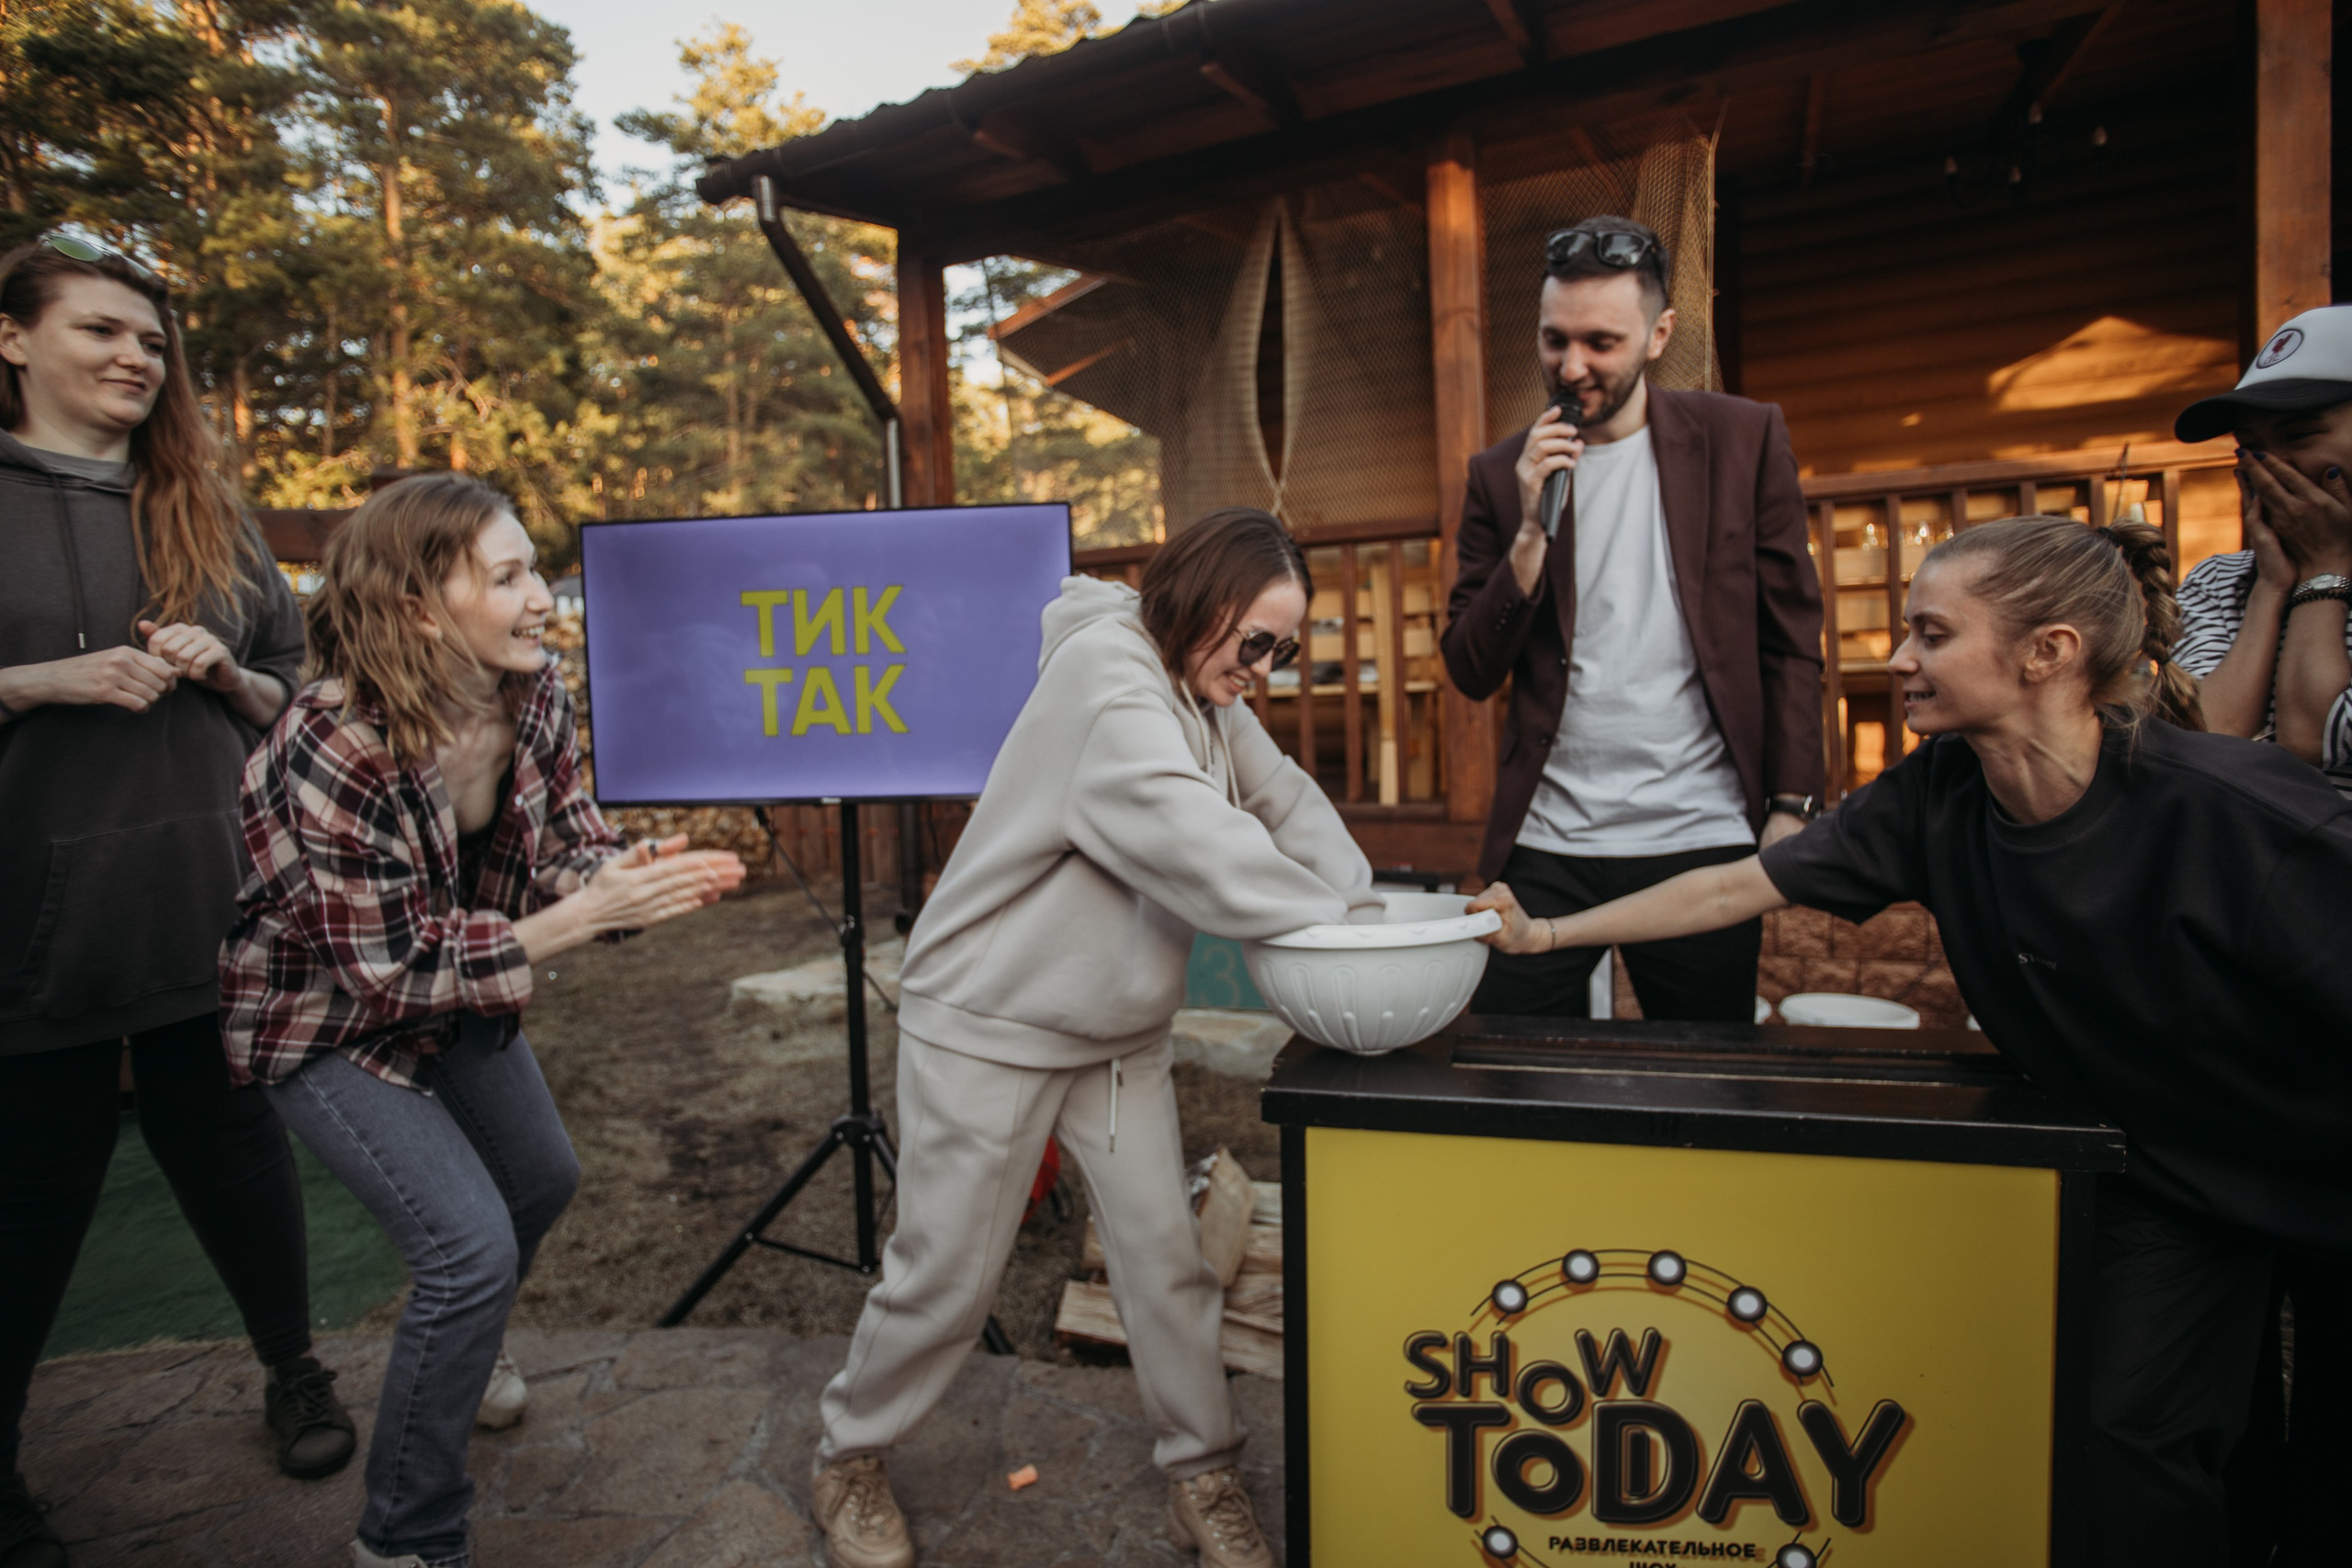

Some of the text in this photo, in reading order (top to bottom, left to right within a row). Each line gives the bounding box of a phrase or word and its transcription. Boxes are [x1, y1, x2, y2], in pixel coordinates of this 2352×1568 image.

[741, 585, 907, 657] ТИК
[744, 664, 910, 737] ТАК
[1403, 1327, 1663, 1425] SHOW
[1411, 1399, 1906, 1527] TODAY
[1548, 1536, 1757, 1558] РАЗВЛЕКАТЕЛЬНОЕ
